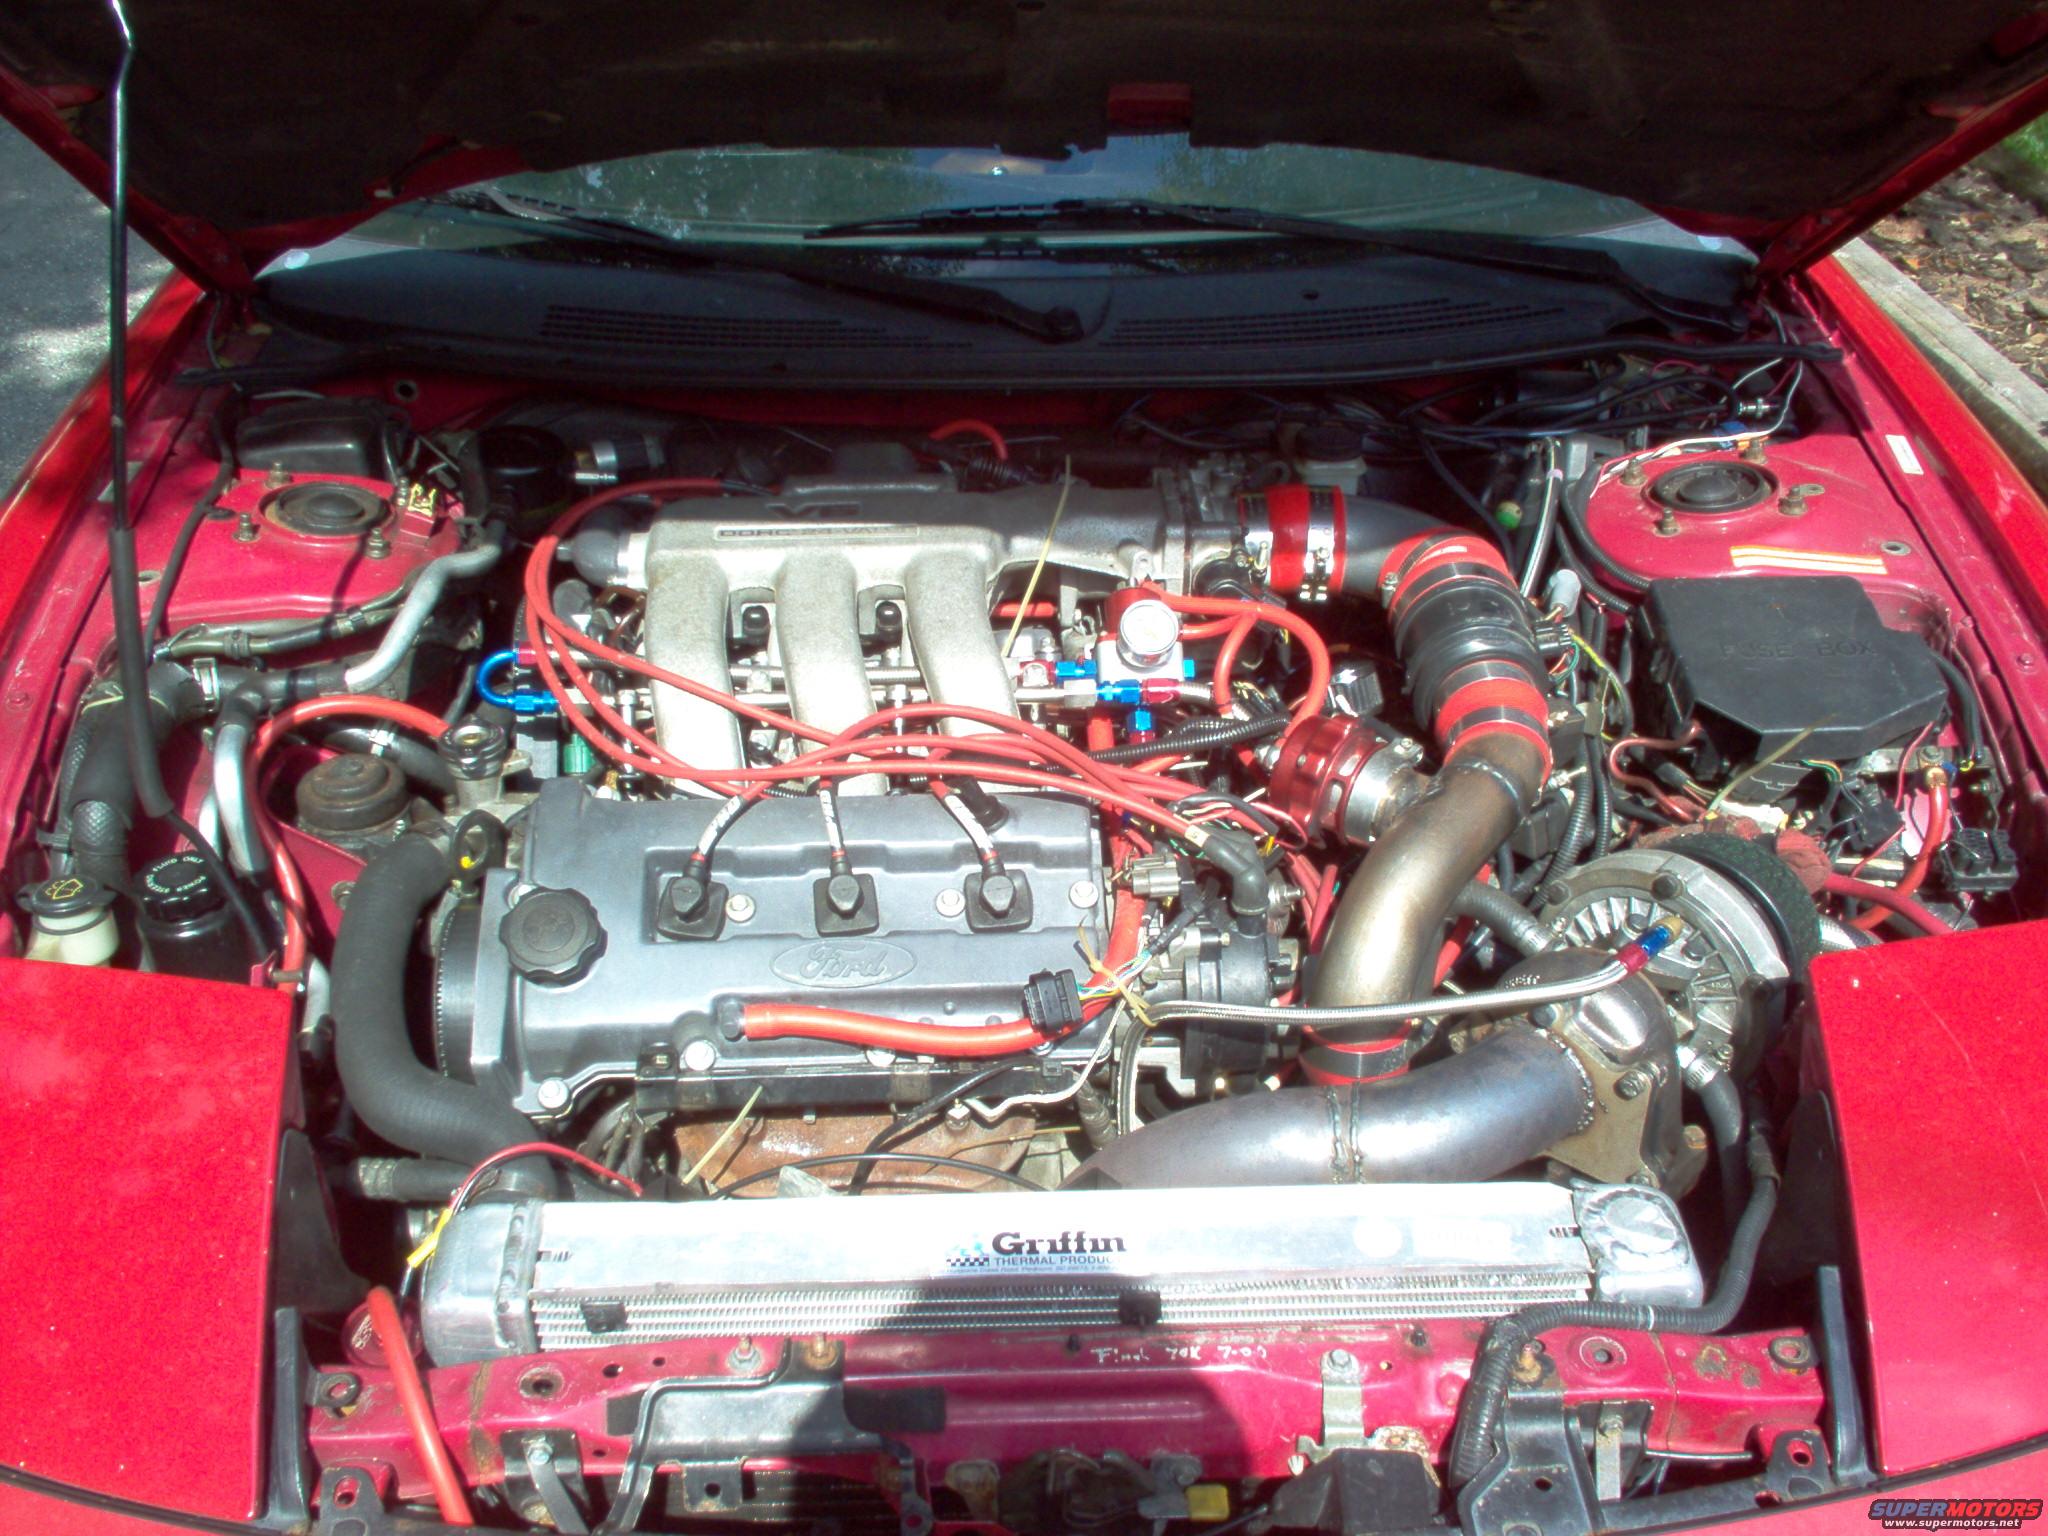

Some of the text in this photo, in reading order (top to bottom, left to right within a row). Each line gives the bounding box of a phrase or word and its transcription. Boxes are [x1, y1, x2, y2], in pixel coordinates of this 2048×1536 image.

[1720, 639, 1873, 659] FUSE BOX
[801, 943, 889, 979] Ford
[992, 1231, 1127, 1256] Griffin
[994, 1254, 1119, 1266] THERMAL PRODUC
